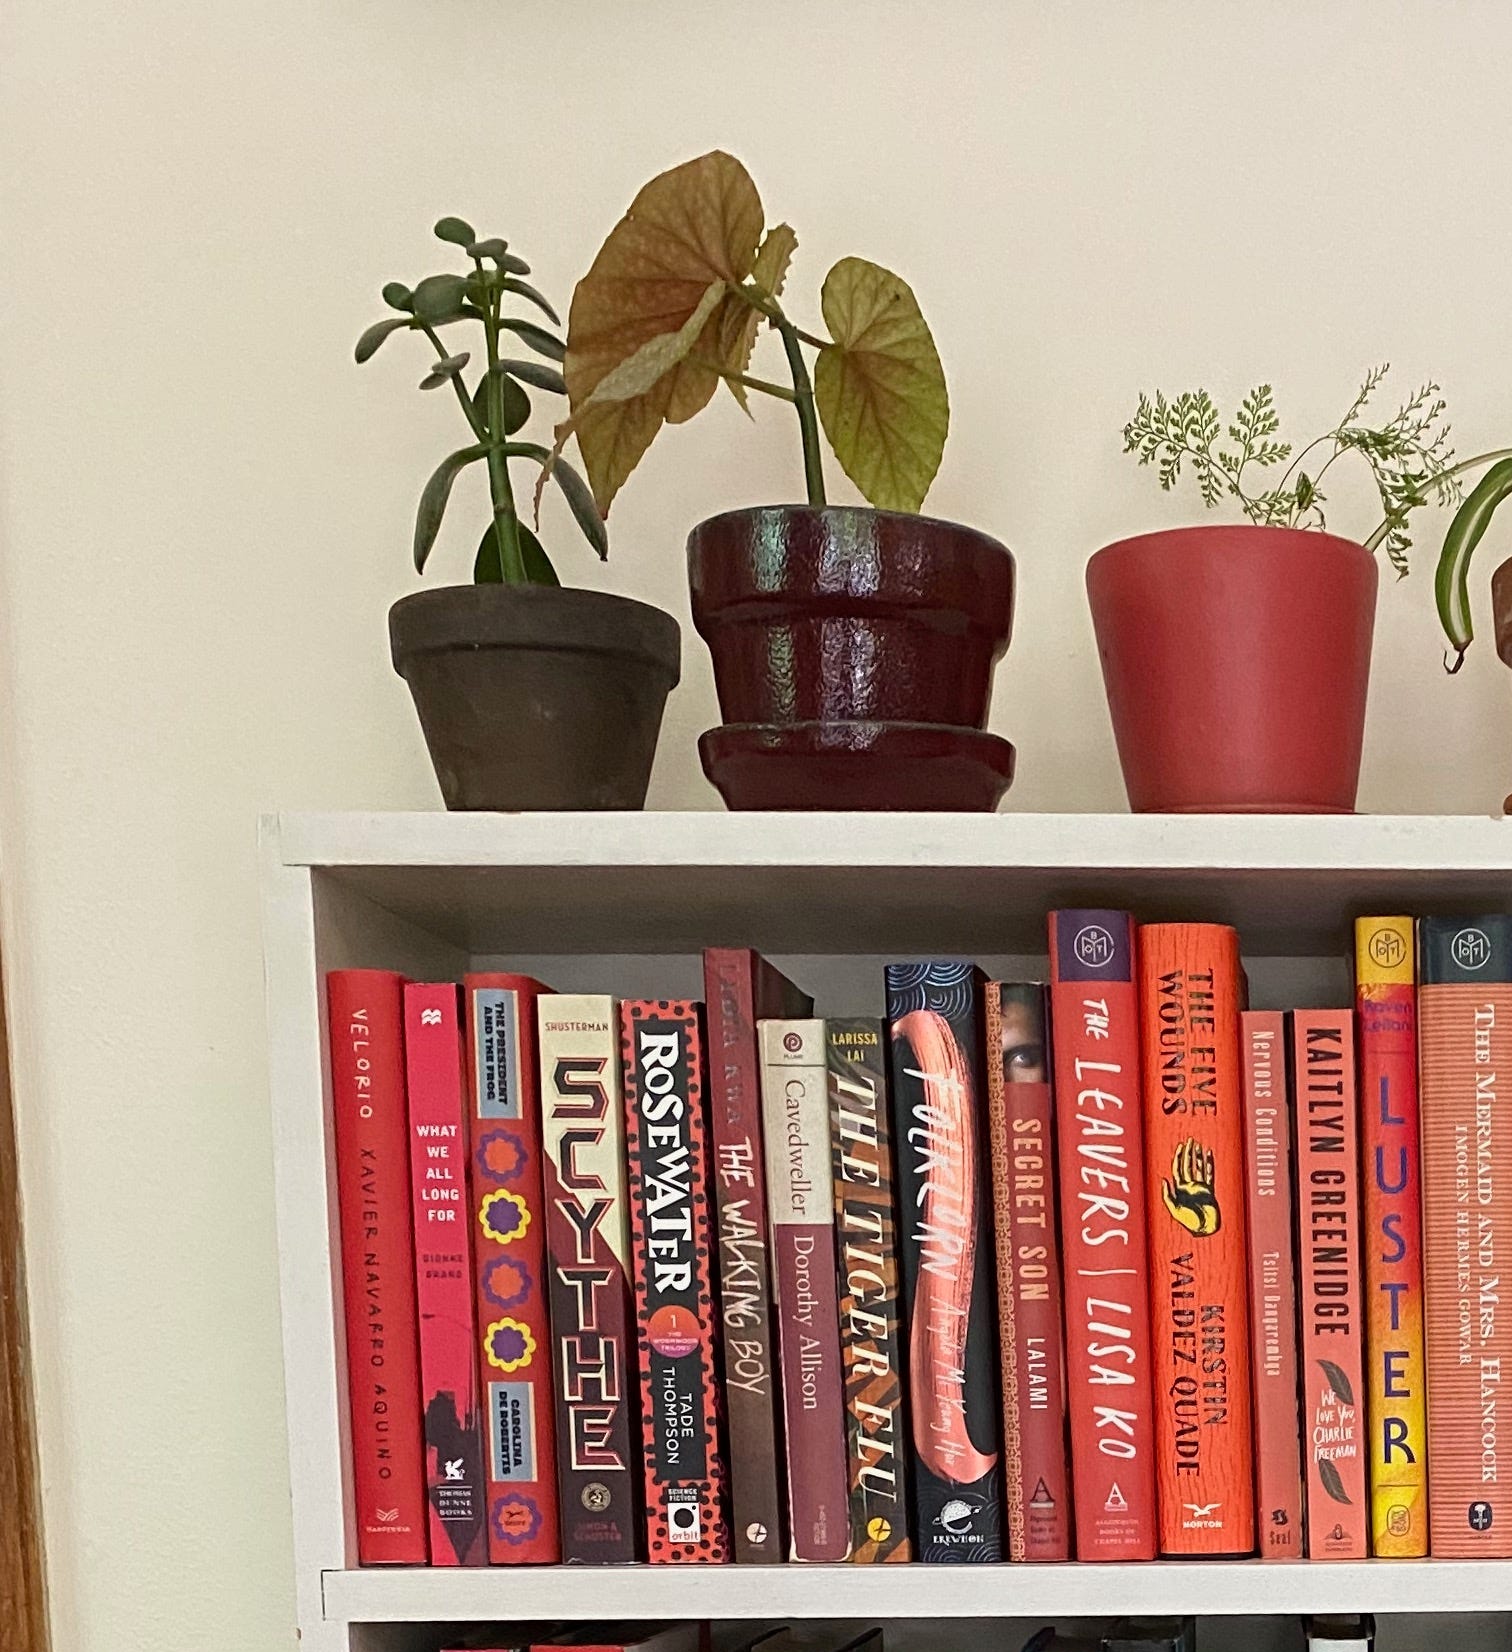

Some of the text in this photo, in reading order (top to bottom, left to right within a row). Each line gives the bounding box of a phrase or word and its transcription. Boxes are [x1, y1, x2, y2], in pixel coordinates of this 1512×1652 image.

[352, 1009, 373, 1119] VELORIO
[545, 1022, 608, 1031] SHUSTERMAN
[832, 1032, 878, 1045] LARISSA
[847, 1051, 865, 1062] LAI
[417, 1125, 459, 1221] WHAT WE ALL LONG FOR
[640, 1031, 692, 1293] ROSEWATER
[719, 1137, 754, 1187] THE
[785, 1079, 811, 1215] Cavedweller
[1307, 1028, 1349, 1335] KAITLYN GREENIDGE
[1013, 1119, 1049, 1299] SECRET SON
[360, 1148, 392, 1480] XAVIER NAVARRO AQUINO
[551, 1057, 625, 1471] SCYTHE
[719, 1200, 764, 1329] WALKING
[1376, 1078, 1416, 1464] LUSTER
[726, 1339, 769, 1395] BOY
[793, 1235, 823, 1409] Dorothy Allison
[663, 1368, 679, 1464] THOMPSON
[680, 1394, 693, 1437] TADE
[1028, 1339, 1047, 1410] LALAMI
[672, 1532, 698, 1541] orbit
